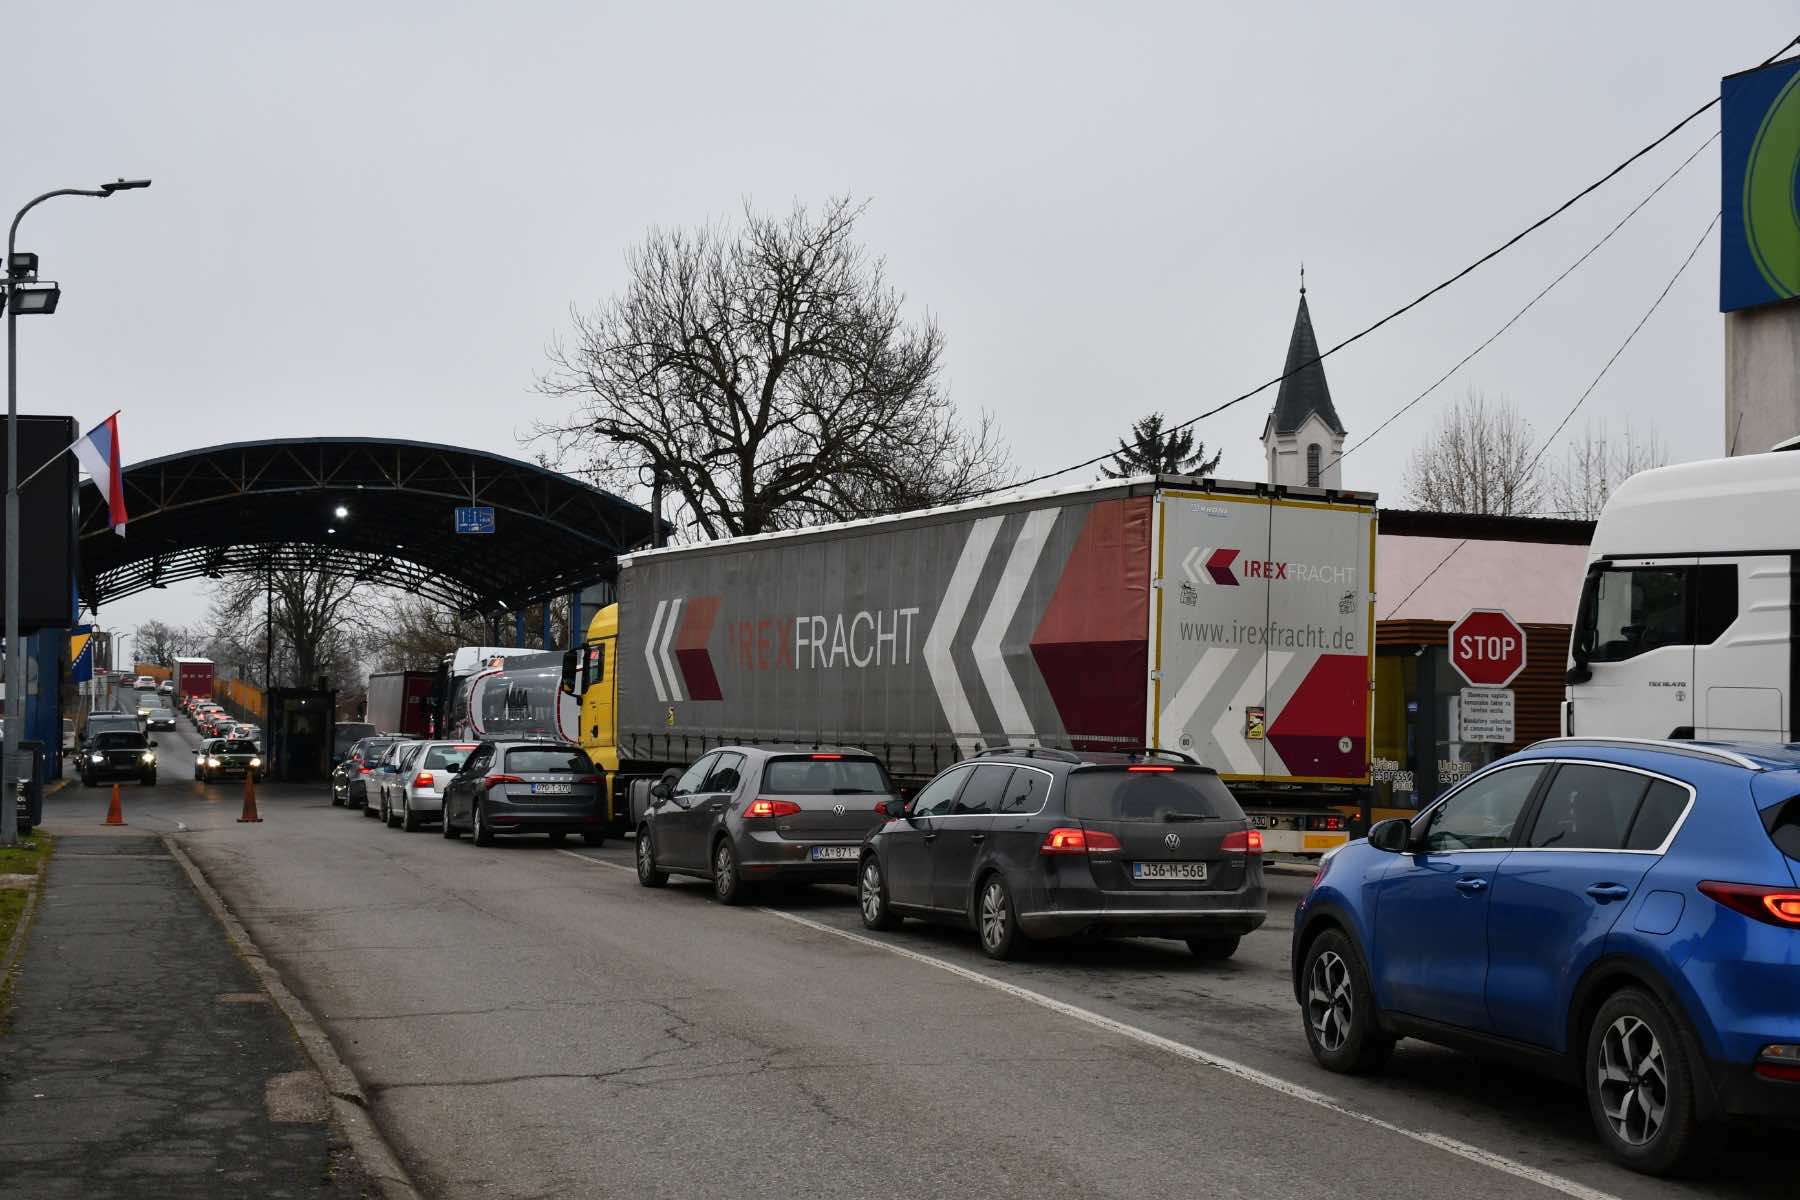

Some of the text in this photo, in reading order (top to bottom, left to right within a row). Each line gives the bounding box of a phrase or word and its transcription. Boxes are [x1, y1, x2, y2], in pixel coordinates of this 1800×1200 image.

[1243, 559, 1355, 584] IREXFRACHT
[1179, 619, 1355, 650] www.irexfracht.de
[1460, 635, 1515, 661] STOP
[1374, 757, 1399, 771] Urban
[1438, 760, 1472, 773] Urban
[1375, 770, 1413, 784] espresso
[1143, 863, 1205, 877] J36-M-568
